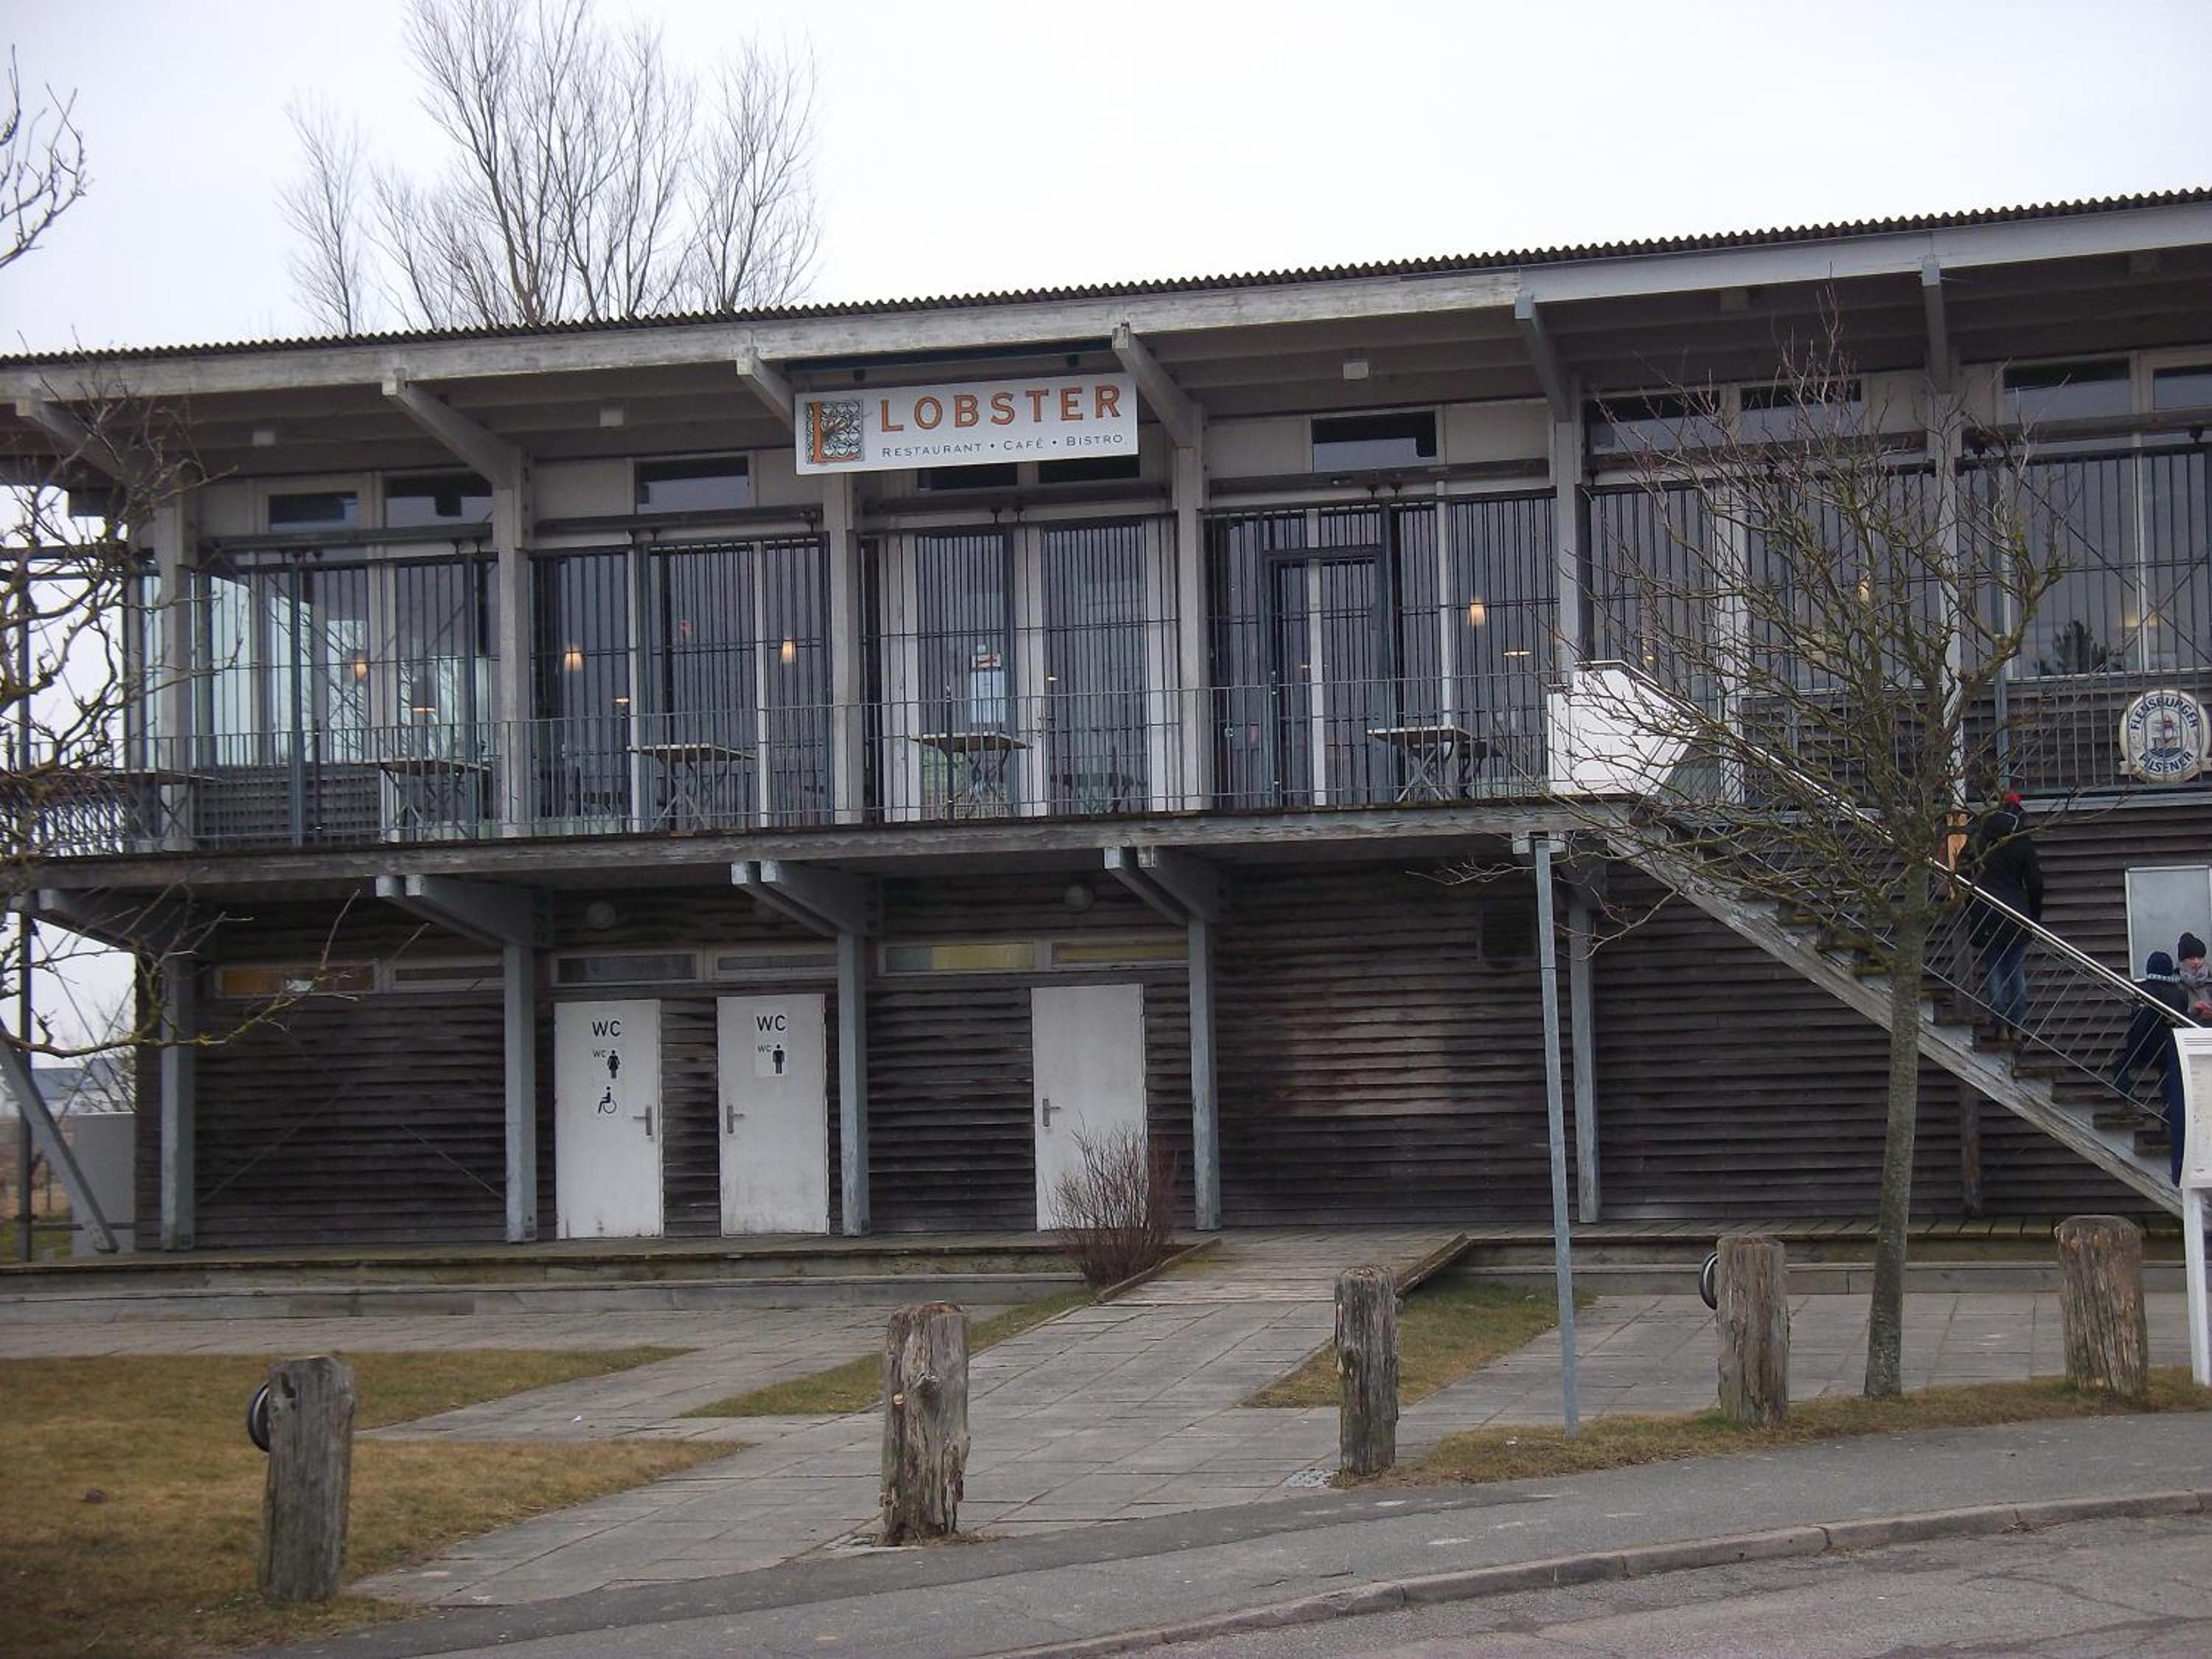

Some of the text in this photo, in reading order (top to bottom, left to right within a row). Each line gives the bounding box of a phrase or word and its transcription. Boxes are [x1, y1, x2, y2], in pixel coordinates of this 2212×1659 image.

[880, 384, 1121, 433] LOBSTER
[883, 434, 1123, 457] RESTAURANT CAFÉ BISTRO
[2130, 697, 2199, 730] FLENSBURGER
[592, 1020, 621, 1037] WC
[757, 1014, 786, 1032] WC
[592, 1049, 606, 1058] WC
[757, 1044, 772, 1053] WC
